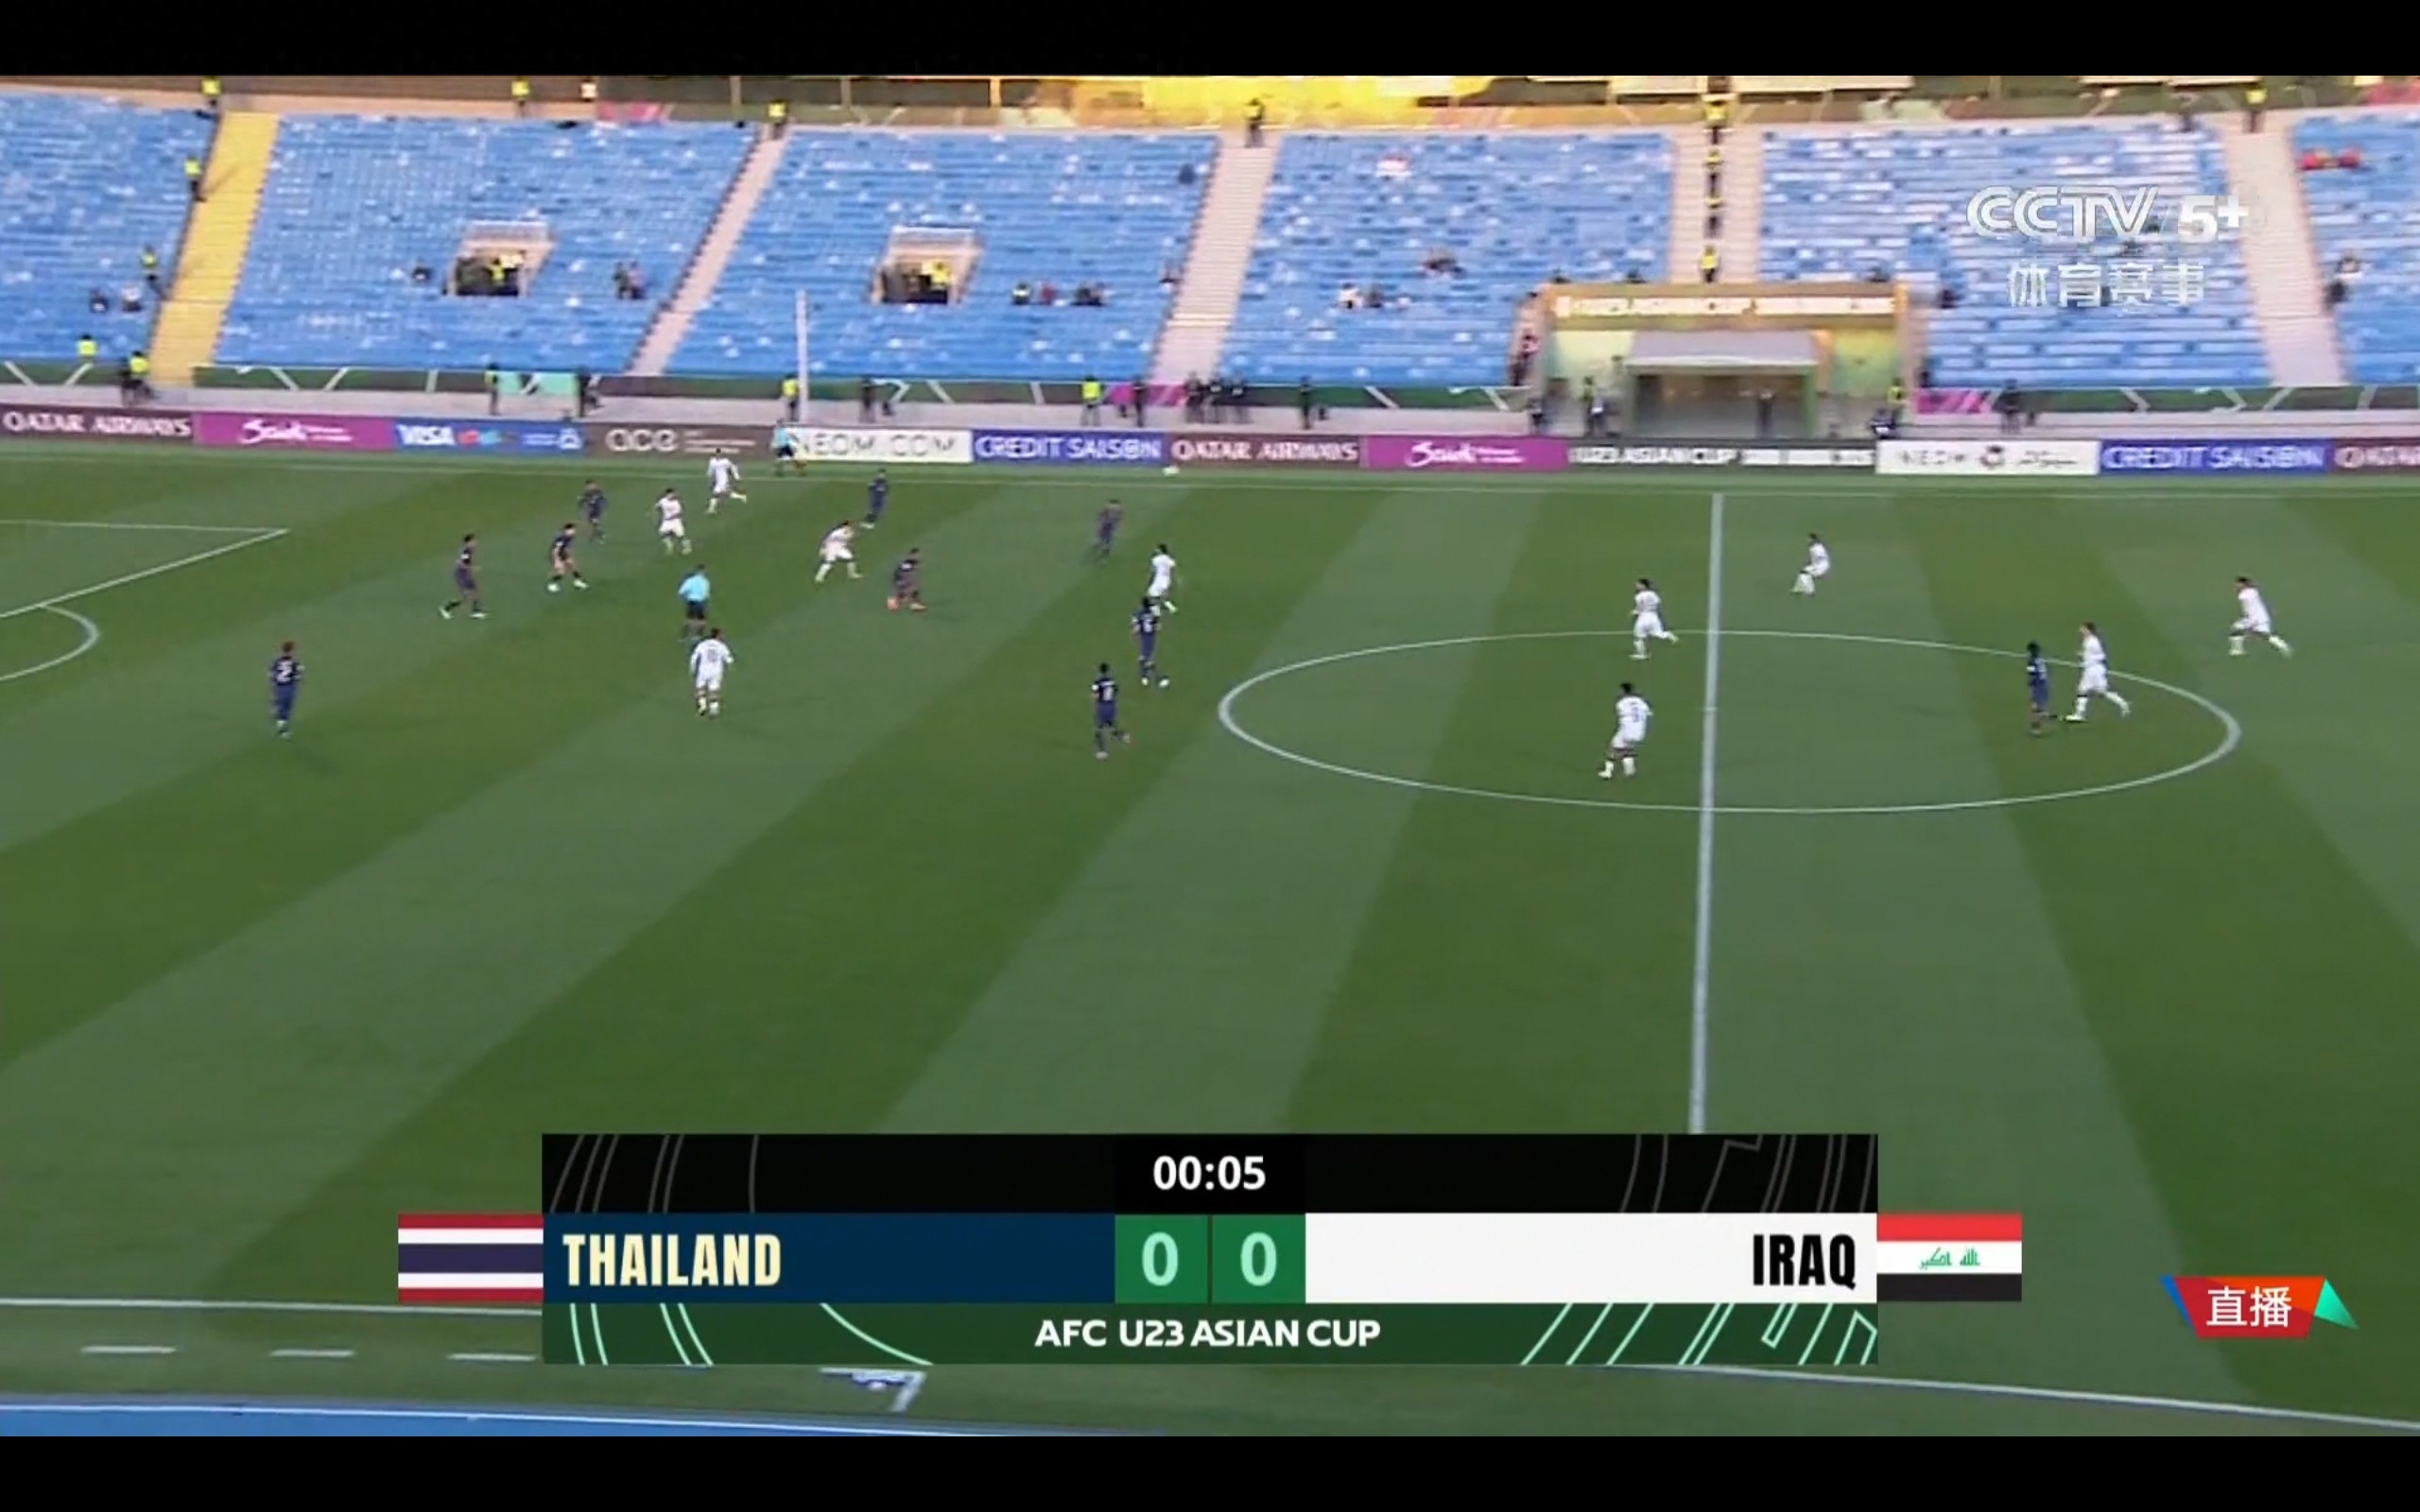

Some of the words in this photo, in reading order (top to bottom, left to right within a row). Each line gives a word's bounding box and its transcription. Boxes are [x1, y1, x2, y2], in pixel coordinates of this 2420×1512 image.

[4, 412, 85, 433] QATAR
[94, 416, 190, 437] AIRWAYS
[396, 424, 456, 446] VISA
[976, 437, 1063, 458] CREDIT
[1065, 439, 1162, 460] SAISON
[1171, 440, 1252, 461] QATAR
[1257, 441, 1358, 462] AIRWAYS
[2101, 446, 2209, 468] CREDIT
